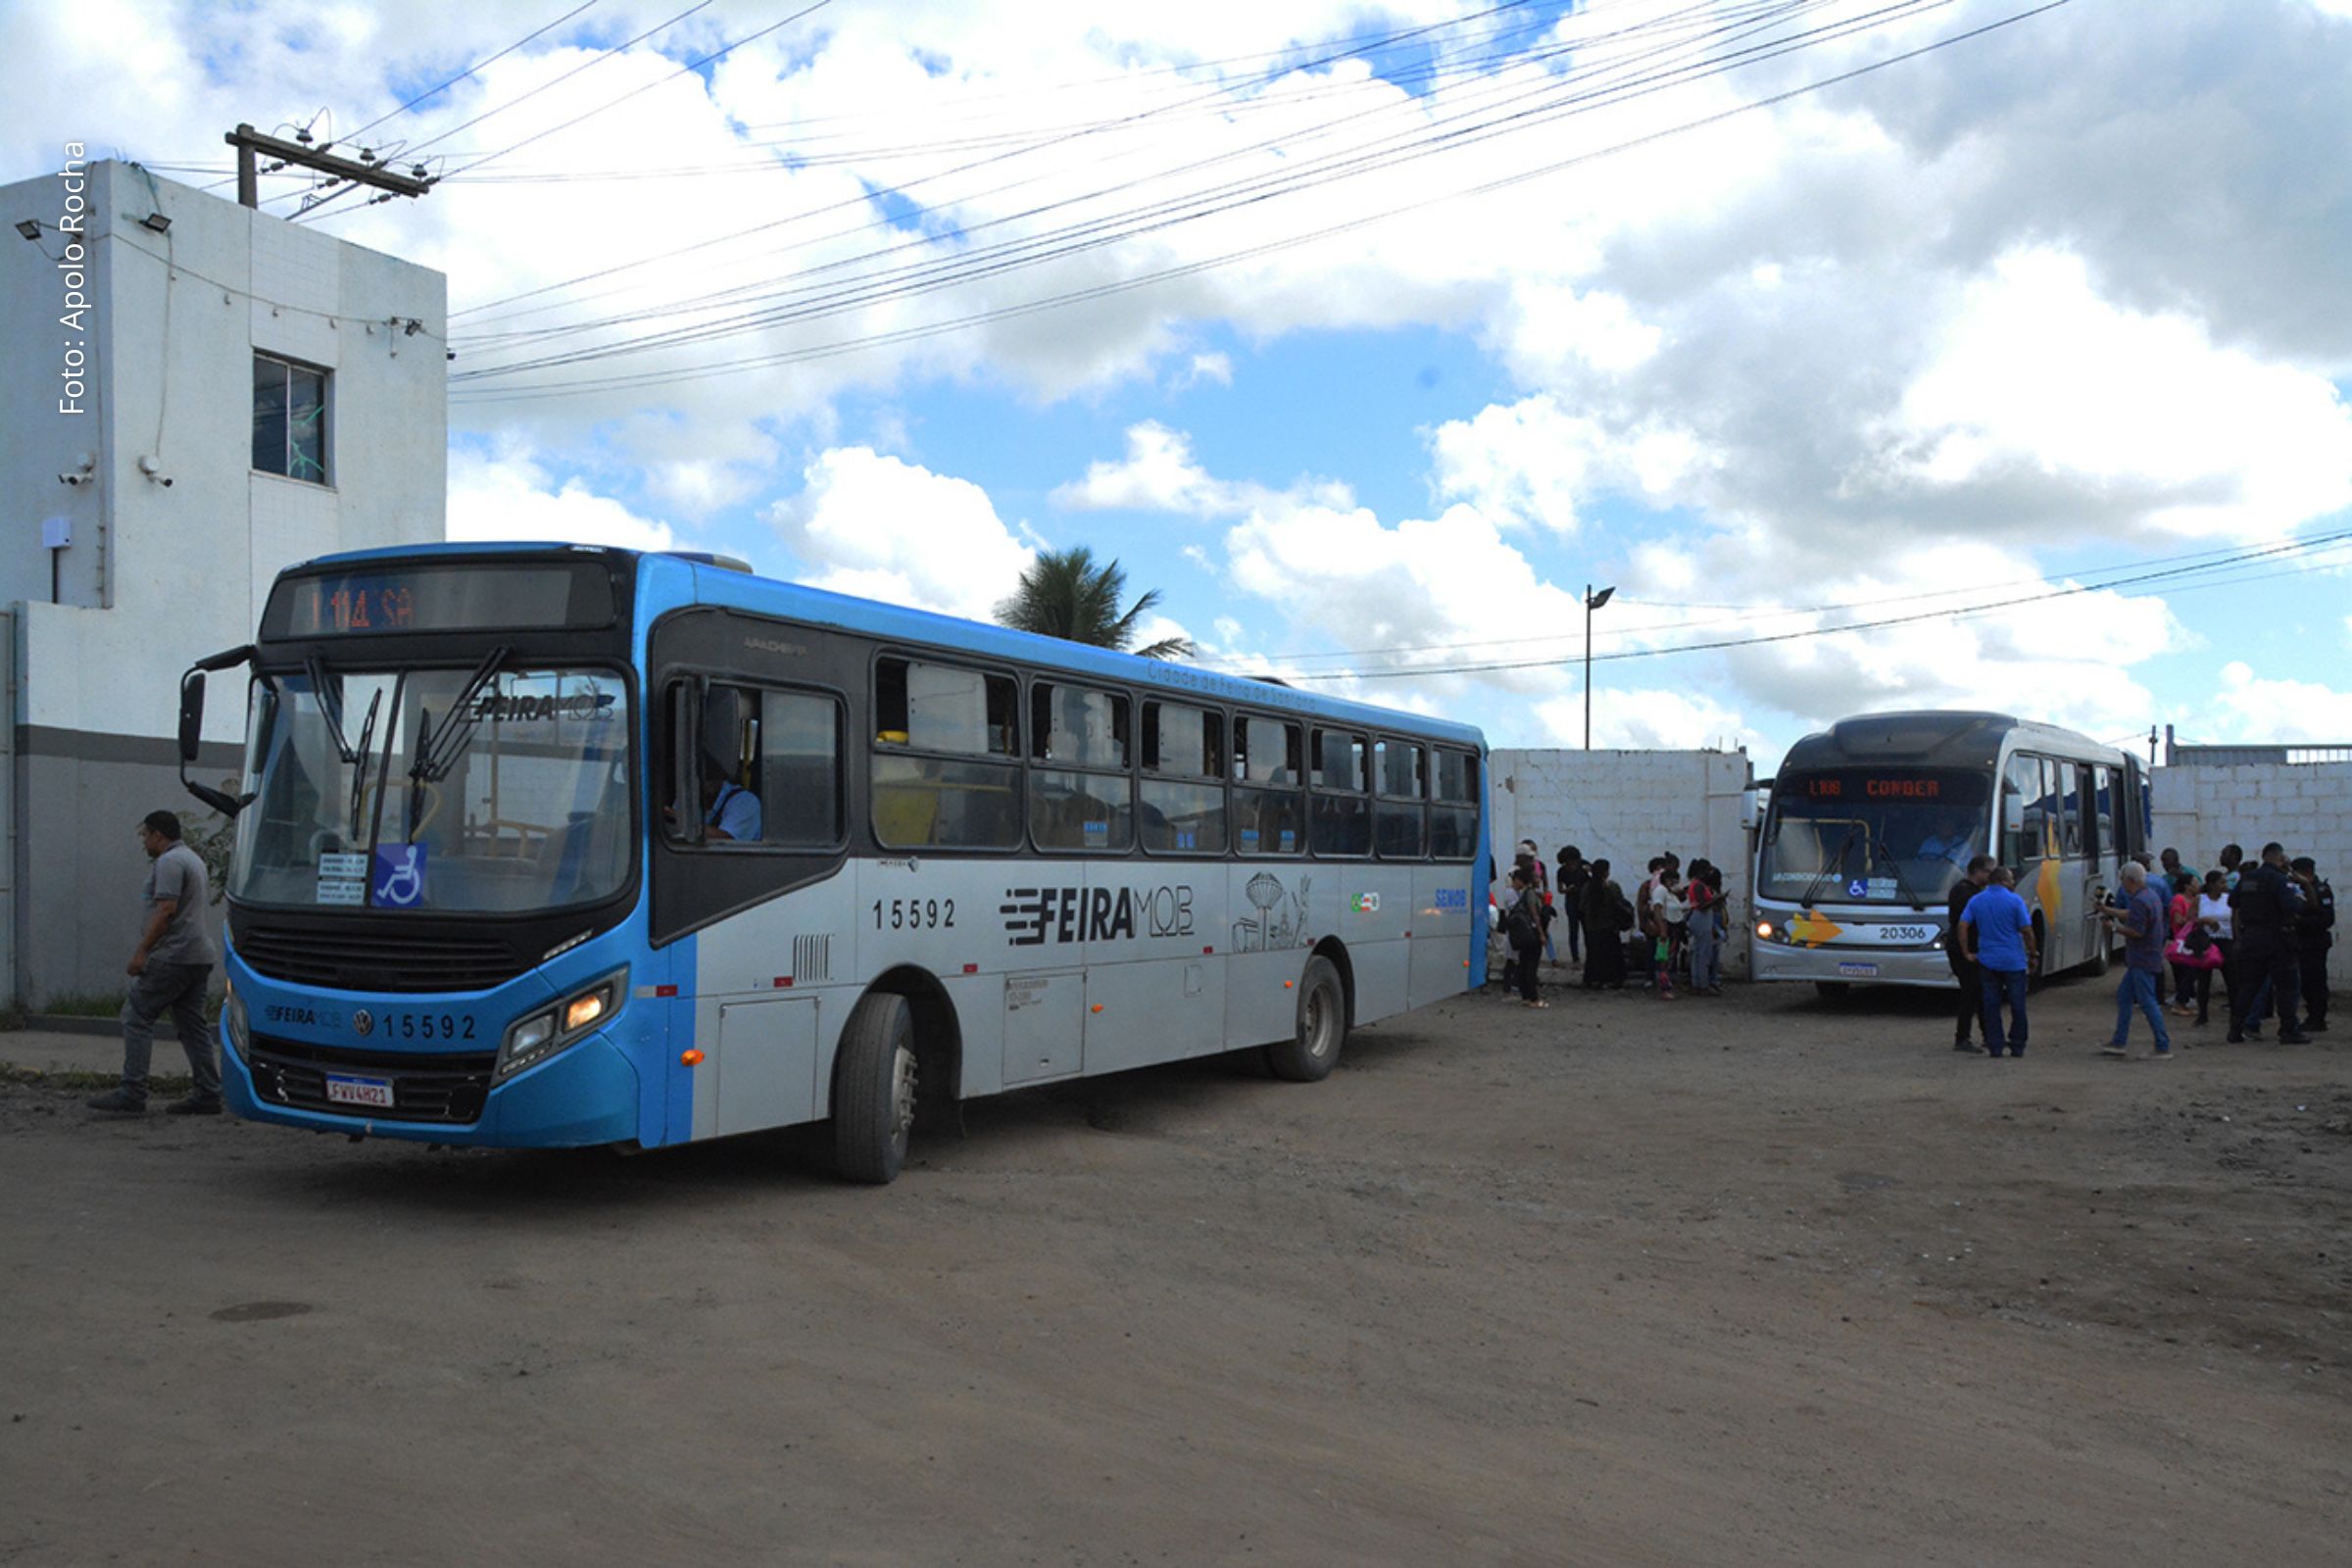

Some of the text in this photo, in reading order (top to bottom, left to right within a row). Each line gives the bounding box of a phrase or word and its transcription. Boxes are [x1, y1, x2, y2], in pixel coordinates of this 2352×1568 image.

[872, 898, 954, 930] 15592
[1880, 927, 1926, 940] 20306
[383, 1014, 475, 1040] 15592
